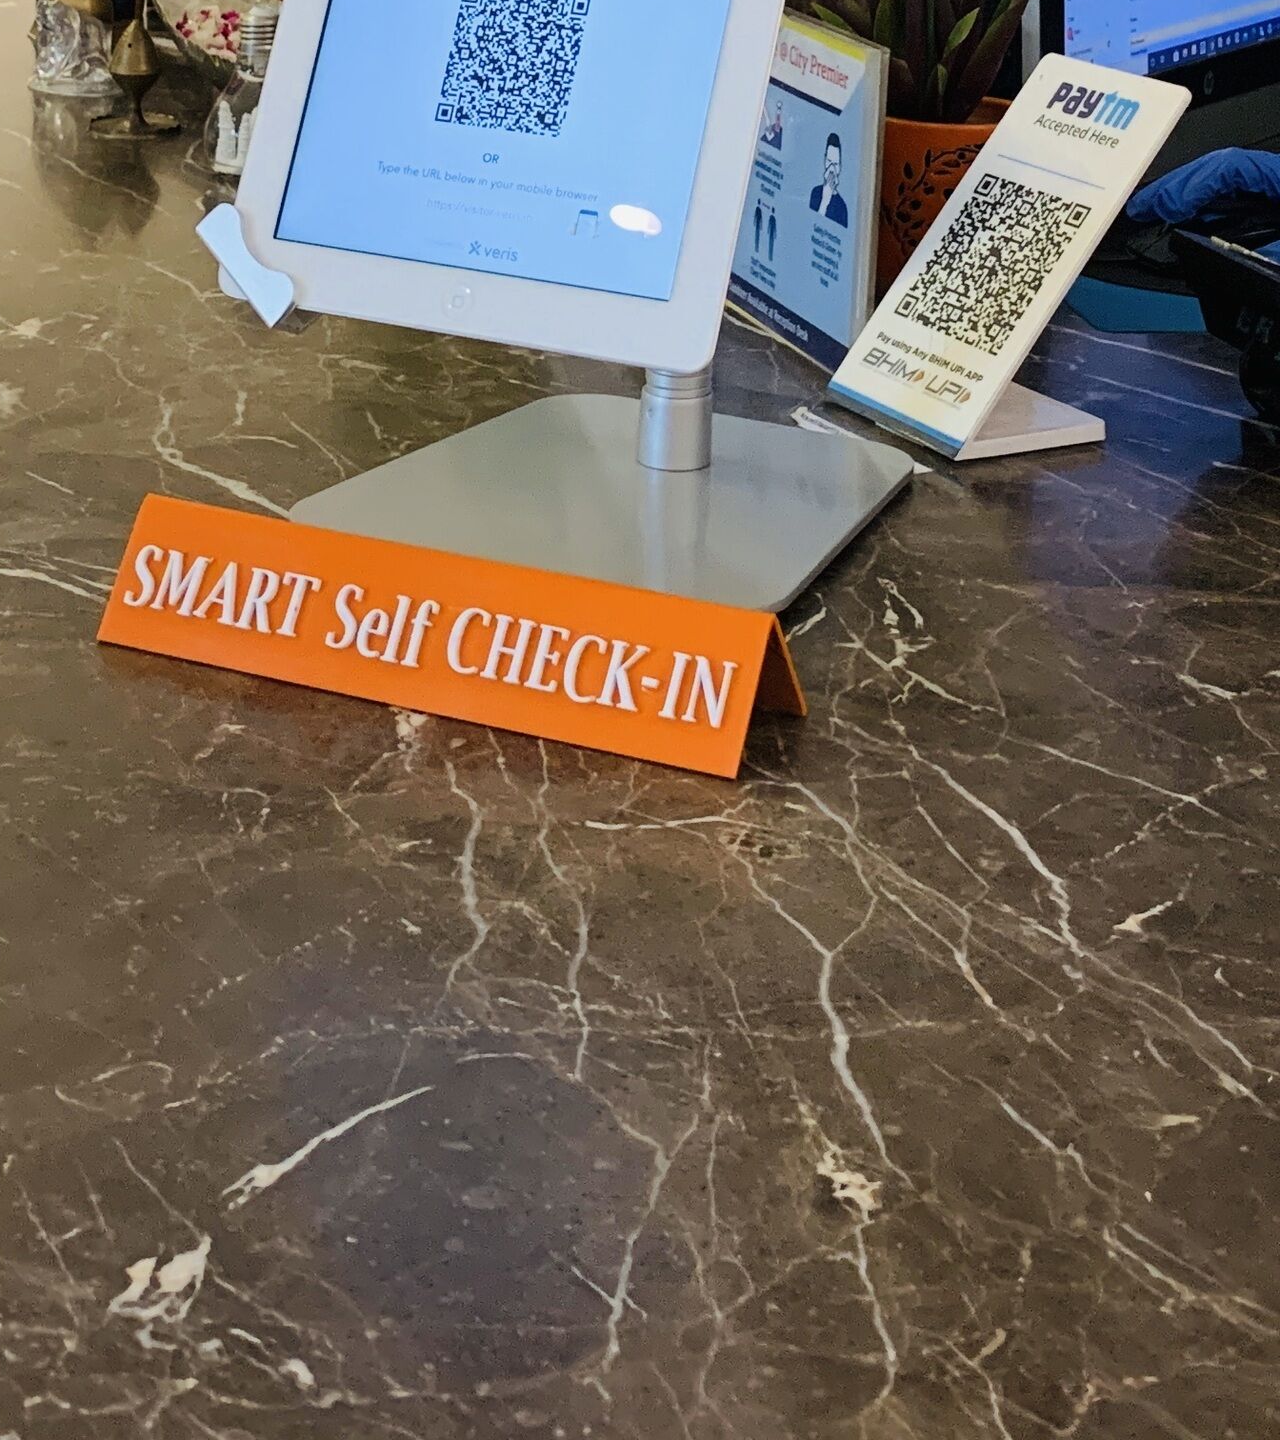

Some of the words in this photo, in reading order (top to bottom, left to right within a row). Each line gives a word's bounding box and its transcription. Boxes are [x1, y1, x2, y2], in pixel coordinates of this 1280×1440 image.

[789, 45, 808, 76] City
[809, 54, 849, 90] Premier
[1033, 114, 1090, 139] Accepted
[1088, 129, 1120, 149] Here
[482, 152, 499, 164] OR
[377, 161, 400, 175] Type
[403, 164, 420, 177] the
[422, 168, 442, 180] URL
[444, 171, 476, 186] below
[478, 177, 488, 187] in
[490, 179, 514, 191] your
[516, 182, 553, 197] mobile
[555, 186, 598, 203] browser
[484, 245, 518, 262] veris
[862, 346, 920, 381] BHIM
[924, 374, 968, 403] UPI
[877, 331, 891, 345] Pay
[891, 338, 912, 354] using
[912, 347, 928, 361] Any
[928, 353, 950, 369] BHIM
[950, 361, 966, 376] UPI
[965, 370, 984, 382] APP
[123, 543, 320, 638] SMART
[325, 582, 440, 669] Self
[447, 606, 739, 729] CHECK-IN
